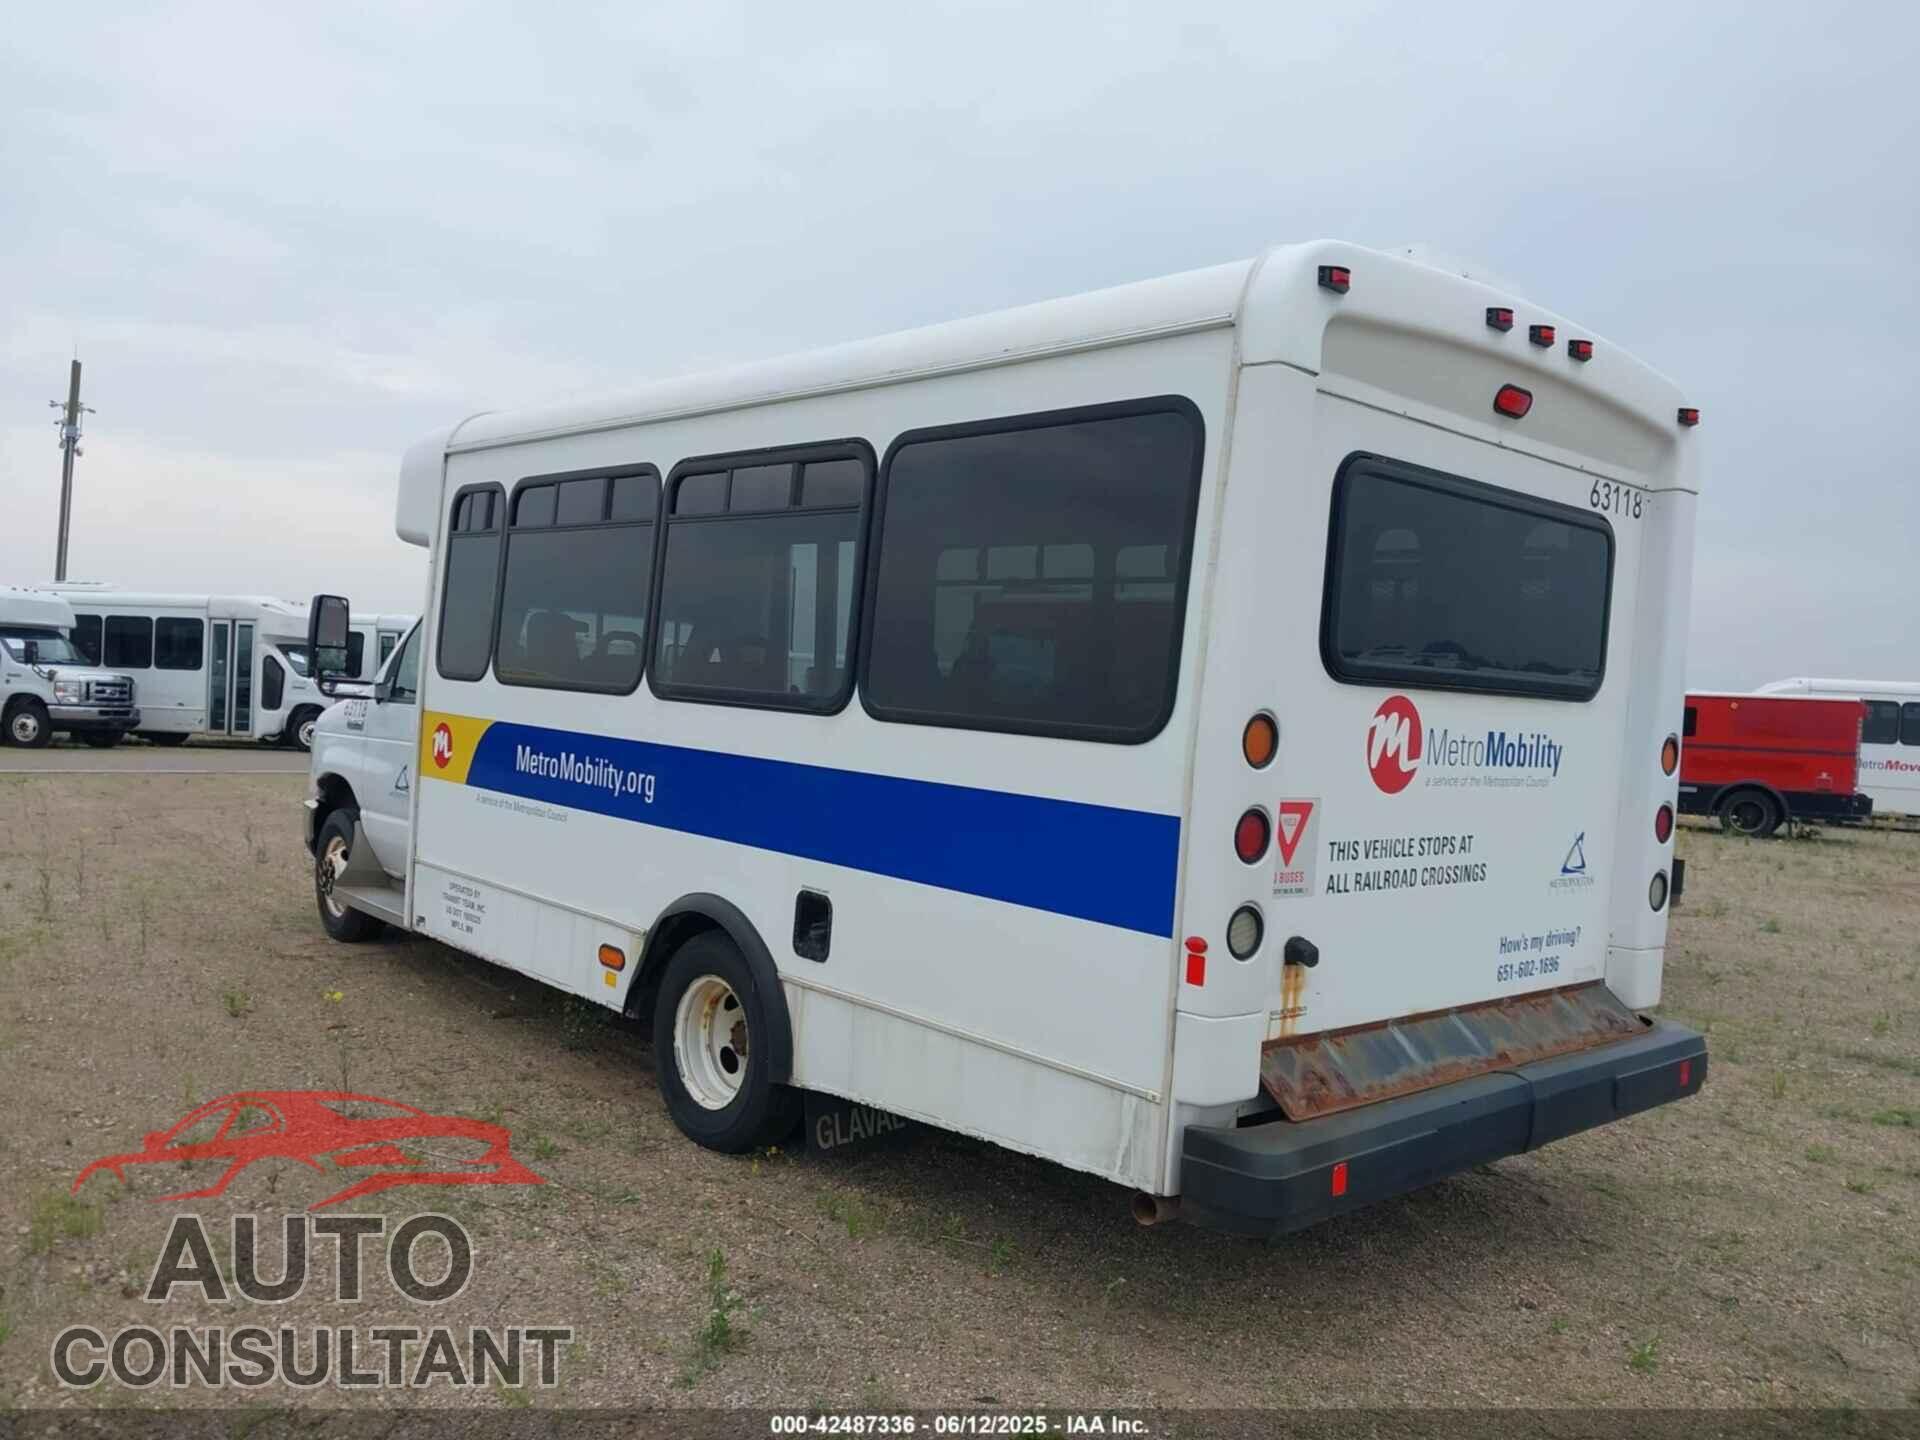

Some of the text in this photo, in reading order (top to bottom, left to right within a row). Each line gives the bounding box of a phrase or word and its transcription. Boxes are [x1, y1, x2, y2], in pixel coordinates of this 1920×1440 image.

[1590, 480, 1642, 519] 63118
[1426, 728, 1563, 777] MetroMobility
[515, 744, 655, 804] MetroMobility.org
[1328, 835, 1474, 862] THIS VEHICLE STOPS AT
[1326, 862, 1488, 895] ALL RAILROAD CROSSINGS
[1500, 926, 1582, 954] How's my driving?
